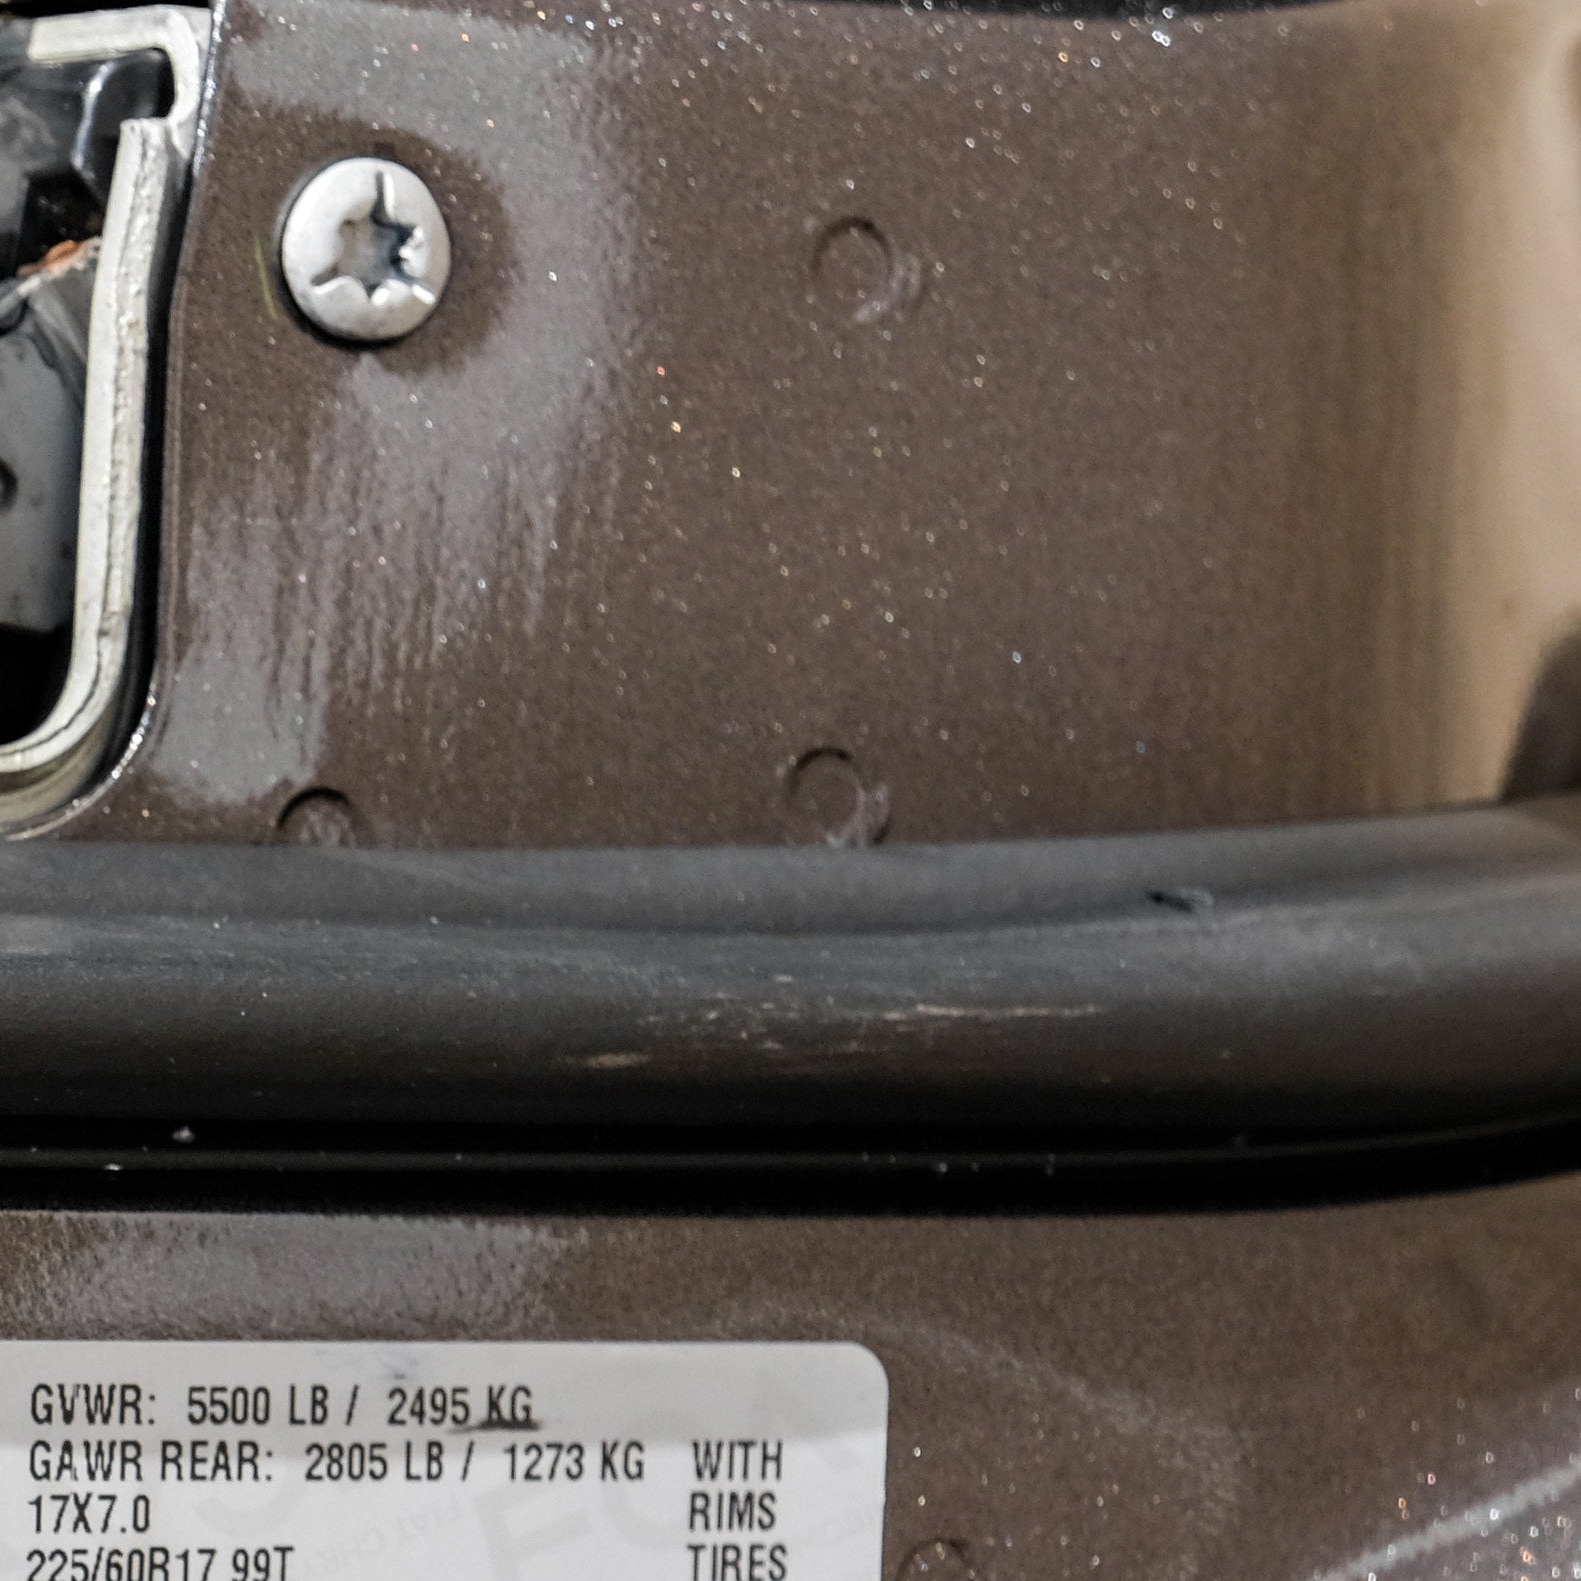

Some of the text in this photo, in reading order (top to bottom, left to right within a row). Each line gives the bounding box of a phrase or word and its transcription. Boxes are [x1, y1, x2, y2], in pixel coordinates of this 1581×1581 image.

[31, 1384, 154, 1424] GVWR:
[188, 1387, 269, 1425] 5500
[290, 1385, 328, 1425] LB
[388, 1388, 469, 1426] 2495
[483, 1388, 535, 1424] KG
[30, 1440, 142, 1481] GAWR
[161, 1440, 272, 1480] REAR:
[306, 1443, 387, 1480] 2805
[406, 1440, 443, 1480] LB
[505, 1442, 584, 1480] 1273
[601, 1440, 643, 1480] KG
[692, 1440, 782, 1480] WITH
[29, 1493, 149, 1533] 17X7.0
[690, 1492, 775, 1530] RIMS
